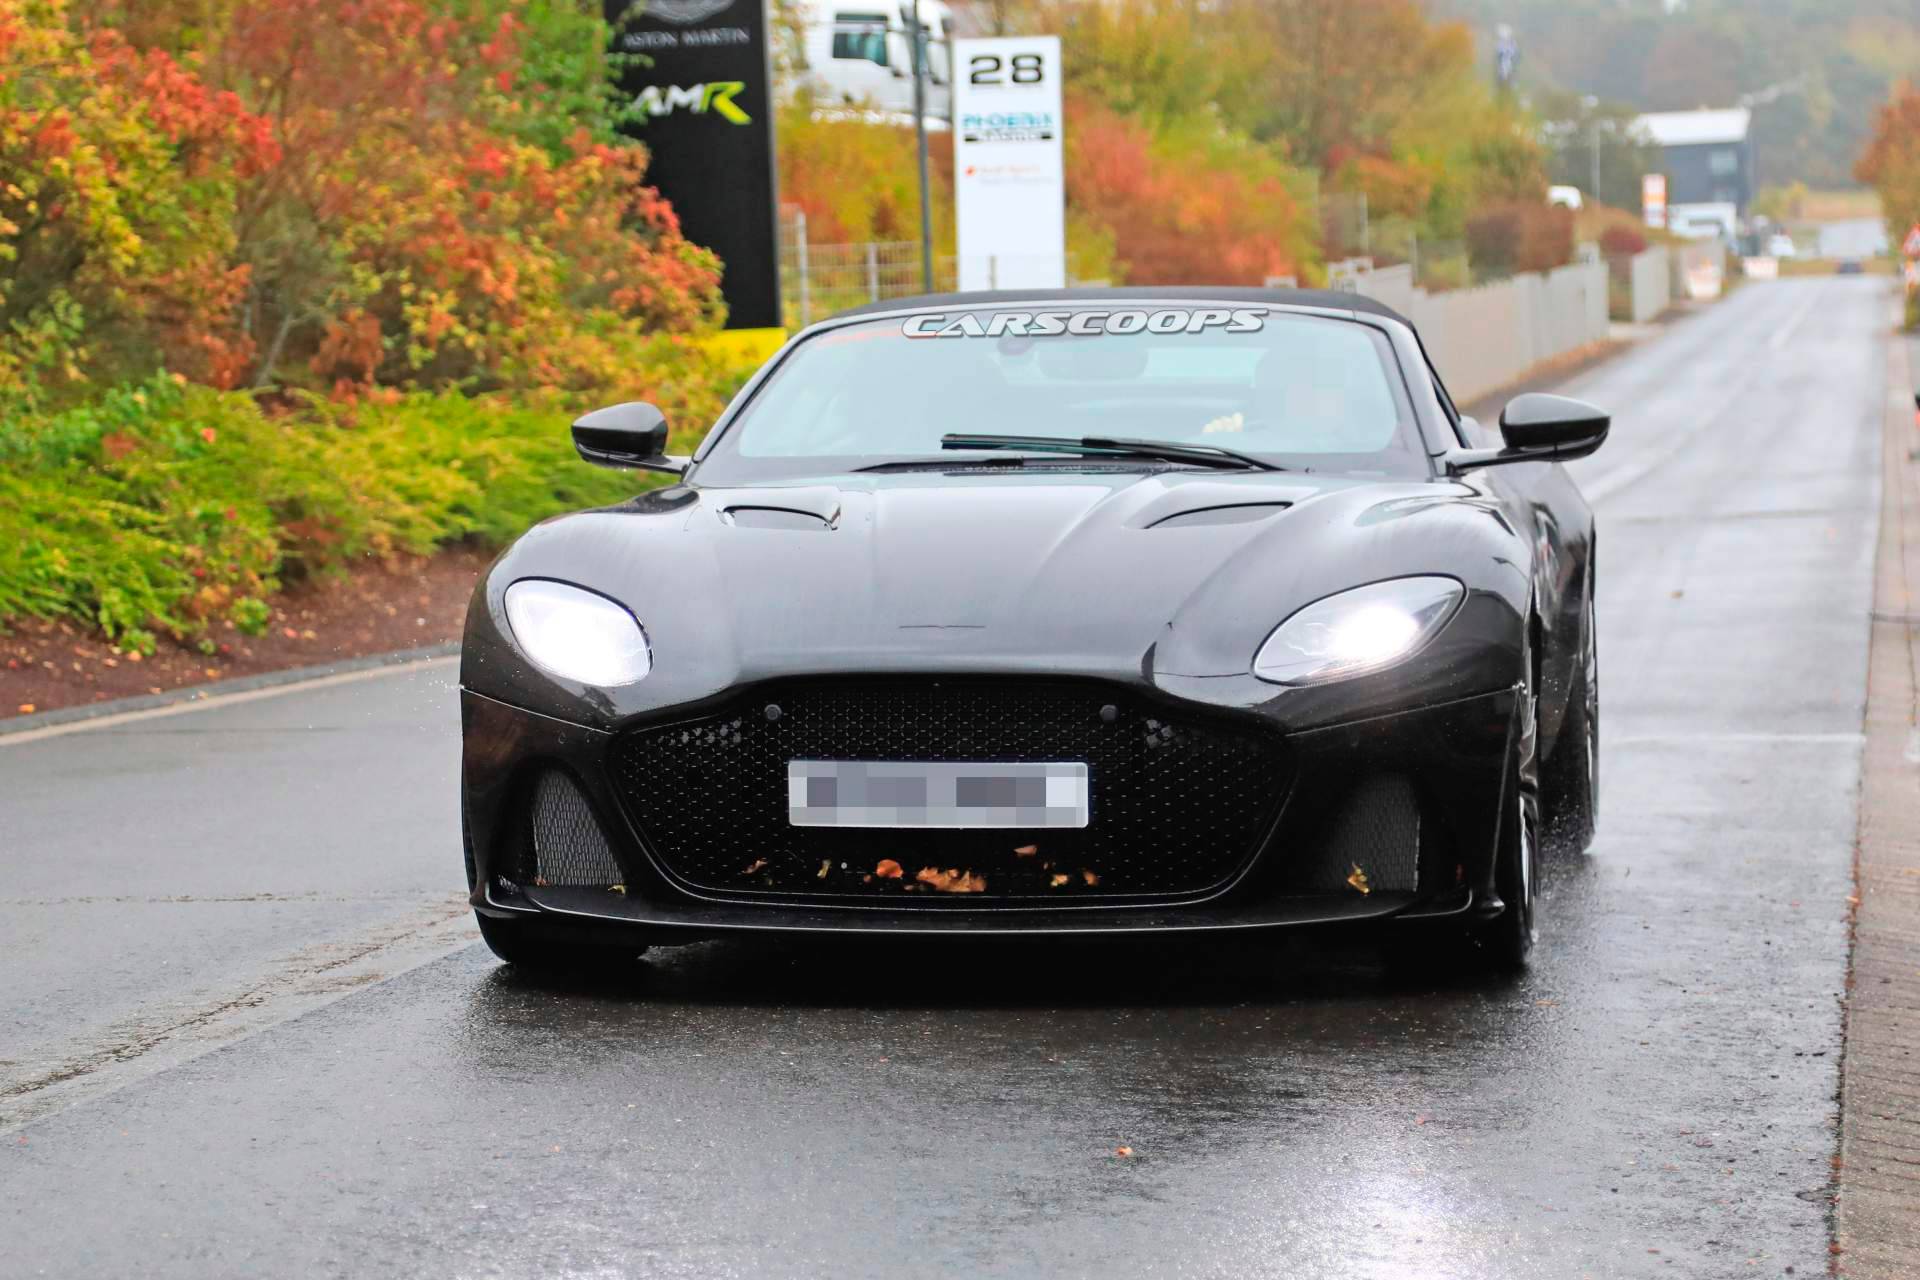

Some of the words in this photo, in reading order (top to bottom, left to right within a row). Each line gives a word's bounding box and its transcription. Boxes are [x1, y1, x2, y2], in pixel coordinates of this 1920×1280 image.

[624, 31, 678, 48] ASTON
[681, 27, 750, 46] MARTIN
[970, 55, 1043, 84] 28
[633, 81, 752, 125] AMR
